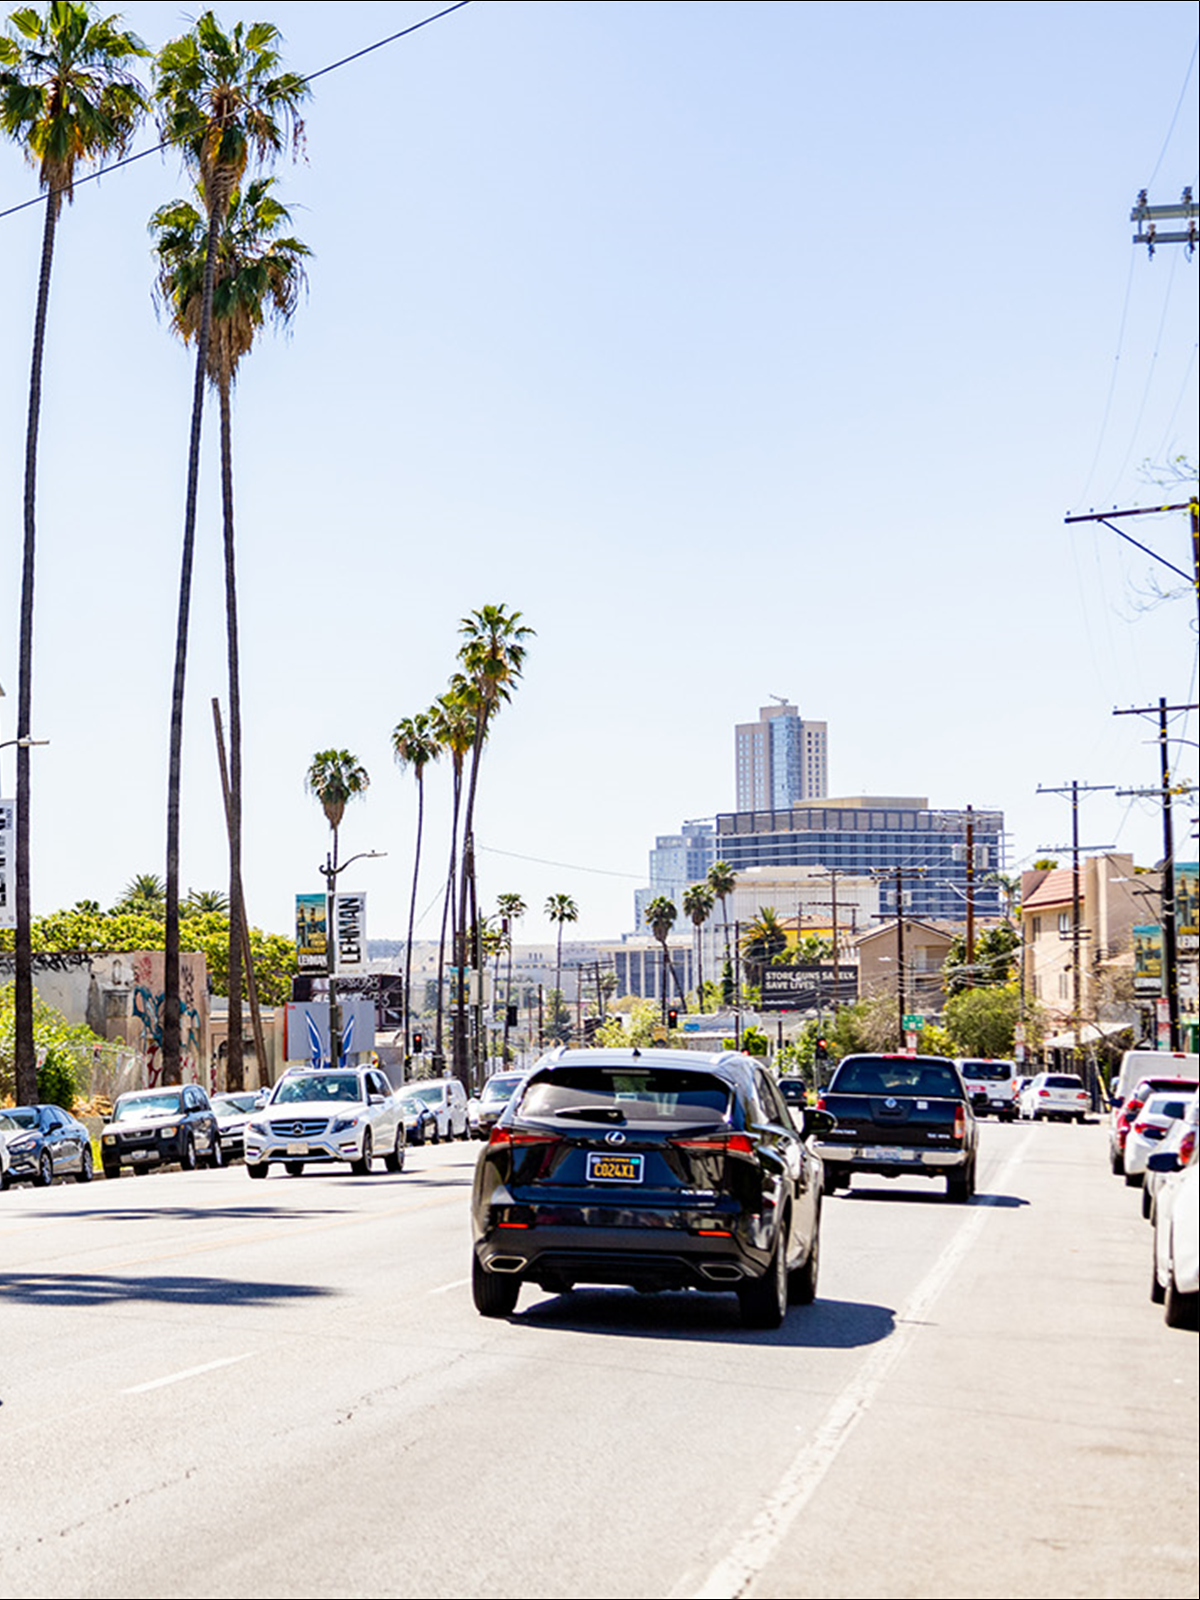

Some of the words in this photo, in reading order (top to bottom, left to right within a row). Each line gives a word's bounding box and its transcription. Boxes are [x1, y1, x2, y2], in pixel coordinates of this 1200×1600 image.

[338, 898, 361, 964] LEHMAN
[765, 971, 793, 980] STORE
[821, 971, 856, 980] SAELY.
[765, 981, 788, 990] SAVE
